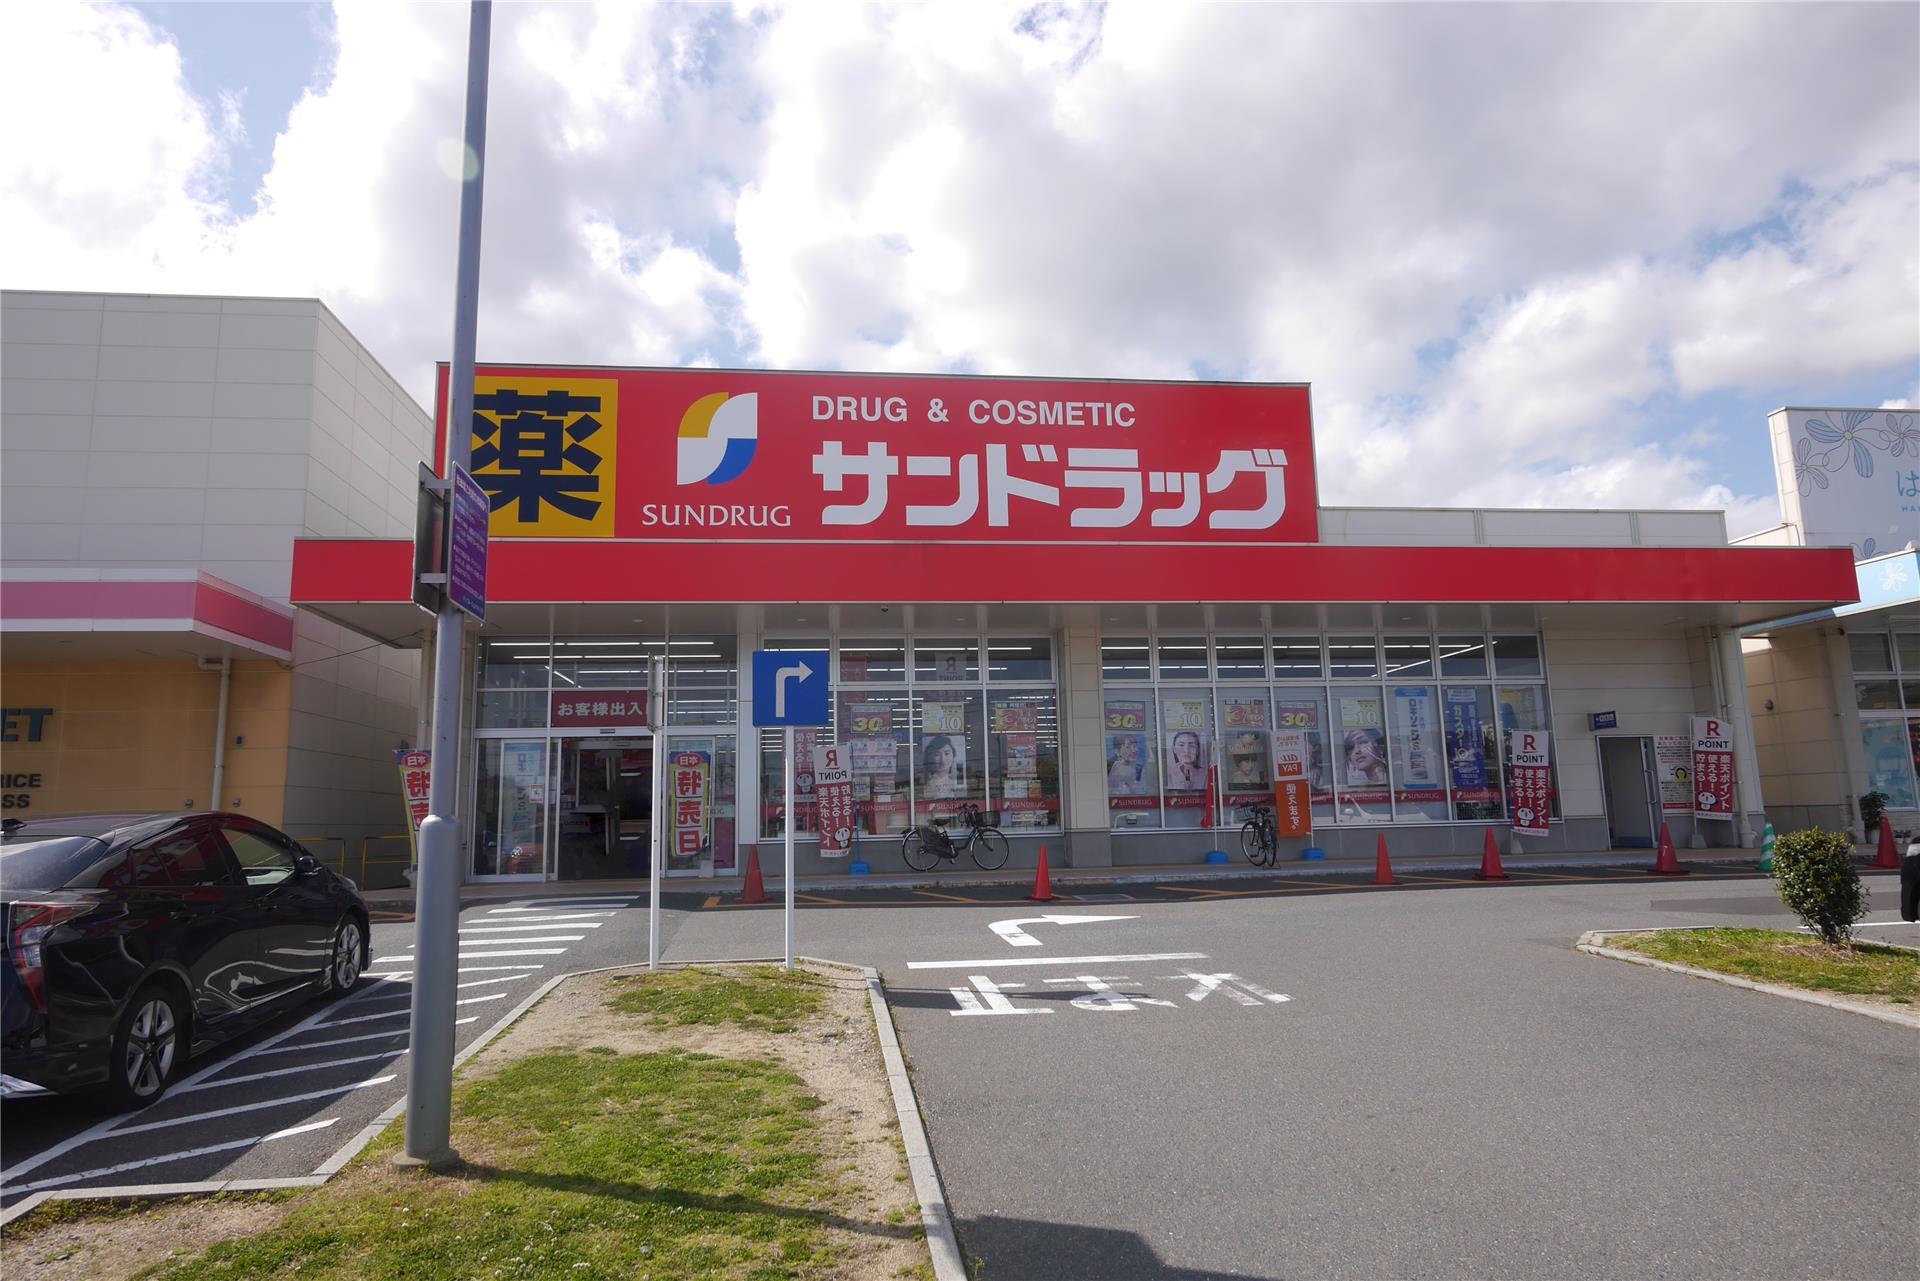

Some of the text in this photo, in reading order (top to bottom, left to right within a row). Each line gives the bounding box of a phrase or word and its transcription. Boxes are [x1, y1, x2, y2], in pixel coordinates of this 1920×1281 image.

[812, 395, 1136, 428] DRUG & COSMETIC
[472, 389, 602, 523] 薬
[811, 440, 1290, 530] サンドラッグ
[1896, 470, 1920, 497] は
[641, 503, 792, 528] SUNDRUG
[557, 700, 648, 717] お客様出入
[1706, 719, 1721, 737] R
[1522, 734, 1537, 751] R
[1697, 739, 1729, 749] POINT
[1516, 754, 1545, 763] POINT
[948, 967, 1295, 1016] 止まれ
